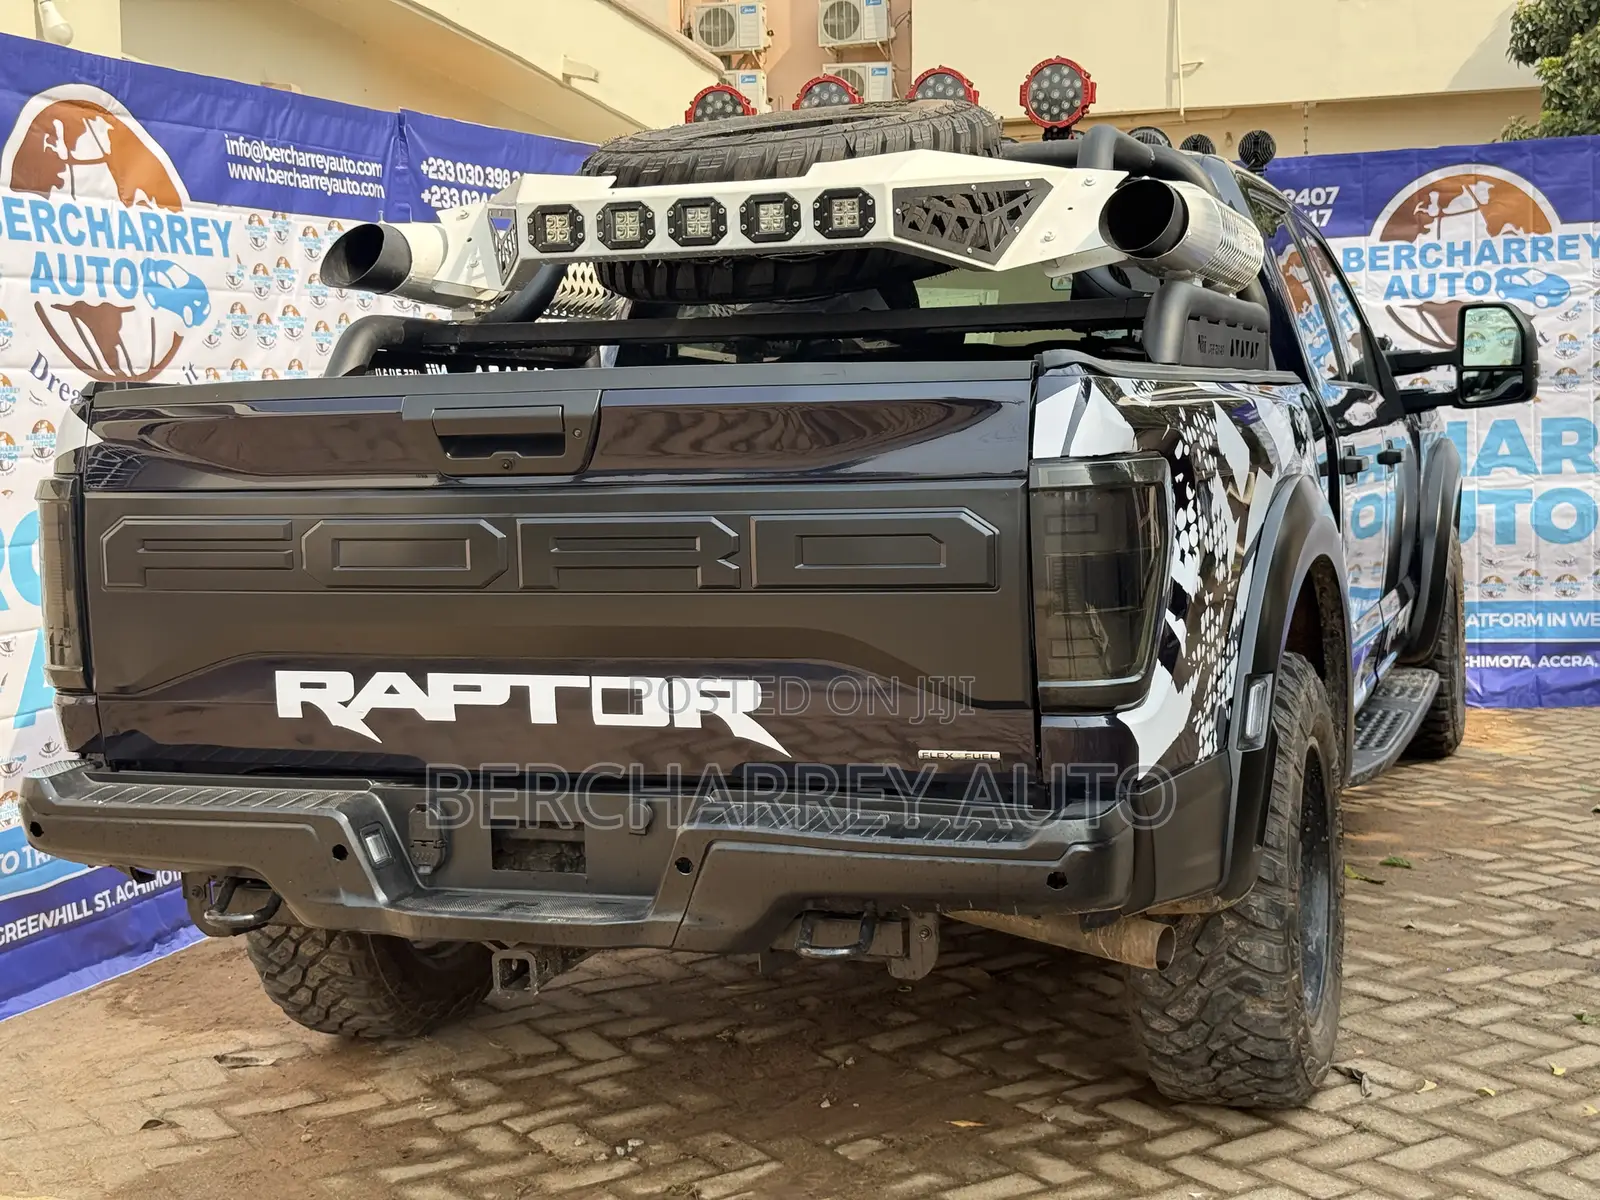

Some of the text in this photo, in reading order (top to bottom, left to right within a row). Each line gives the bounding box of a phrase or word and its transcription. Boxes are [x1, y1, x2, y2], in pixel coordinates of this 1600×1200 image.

[224, 133, 383, 178] info@bercharreyauto.com
[421, 157, 456, 182] +233
[456, 162, 484, 186] 030
[485, 167, 511, 189] 398
[227, 162, 385, 199] www.bercharreyauto.com
[421, 185, 460, 209] +233
[0, 195, 233, 258] ERCHARREY
[1342, 233, 1600, 273] BERCHARREY
[30, 251, 139, 300] AUTO
[1382, 270, 1492, 301] AUTO
[28, 350, 84, 405] Drea
[101, 511, 998, 591] FORD
[1547, 612, 1567, 628] IN
[275, 670, 794, 758] RAPTOR
[921, 752, 999, 761] FLEX FUEL
[94, 890, 116, 914] ST.
